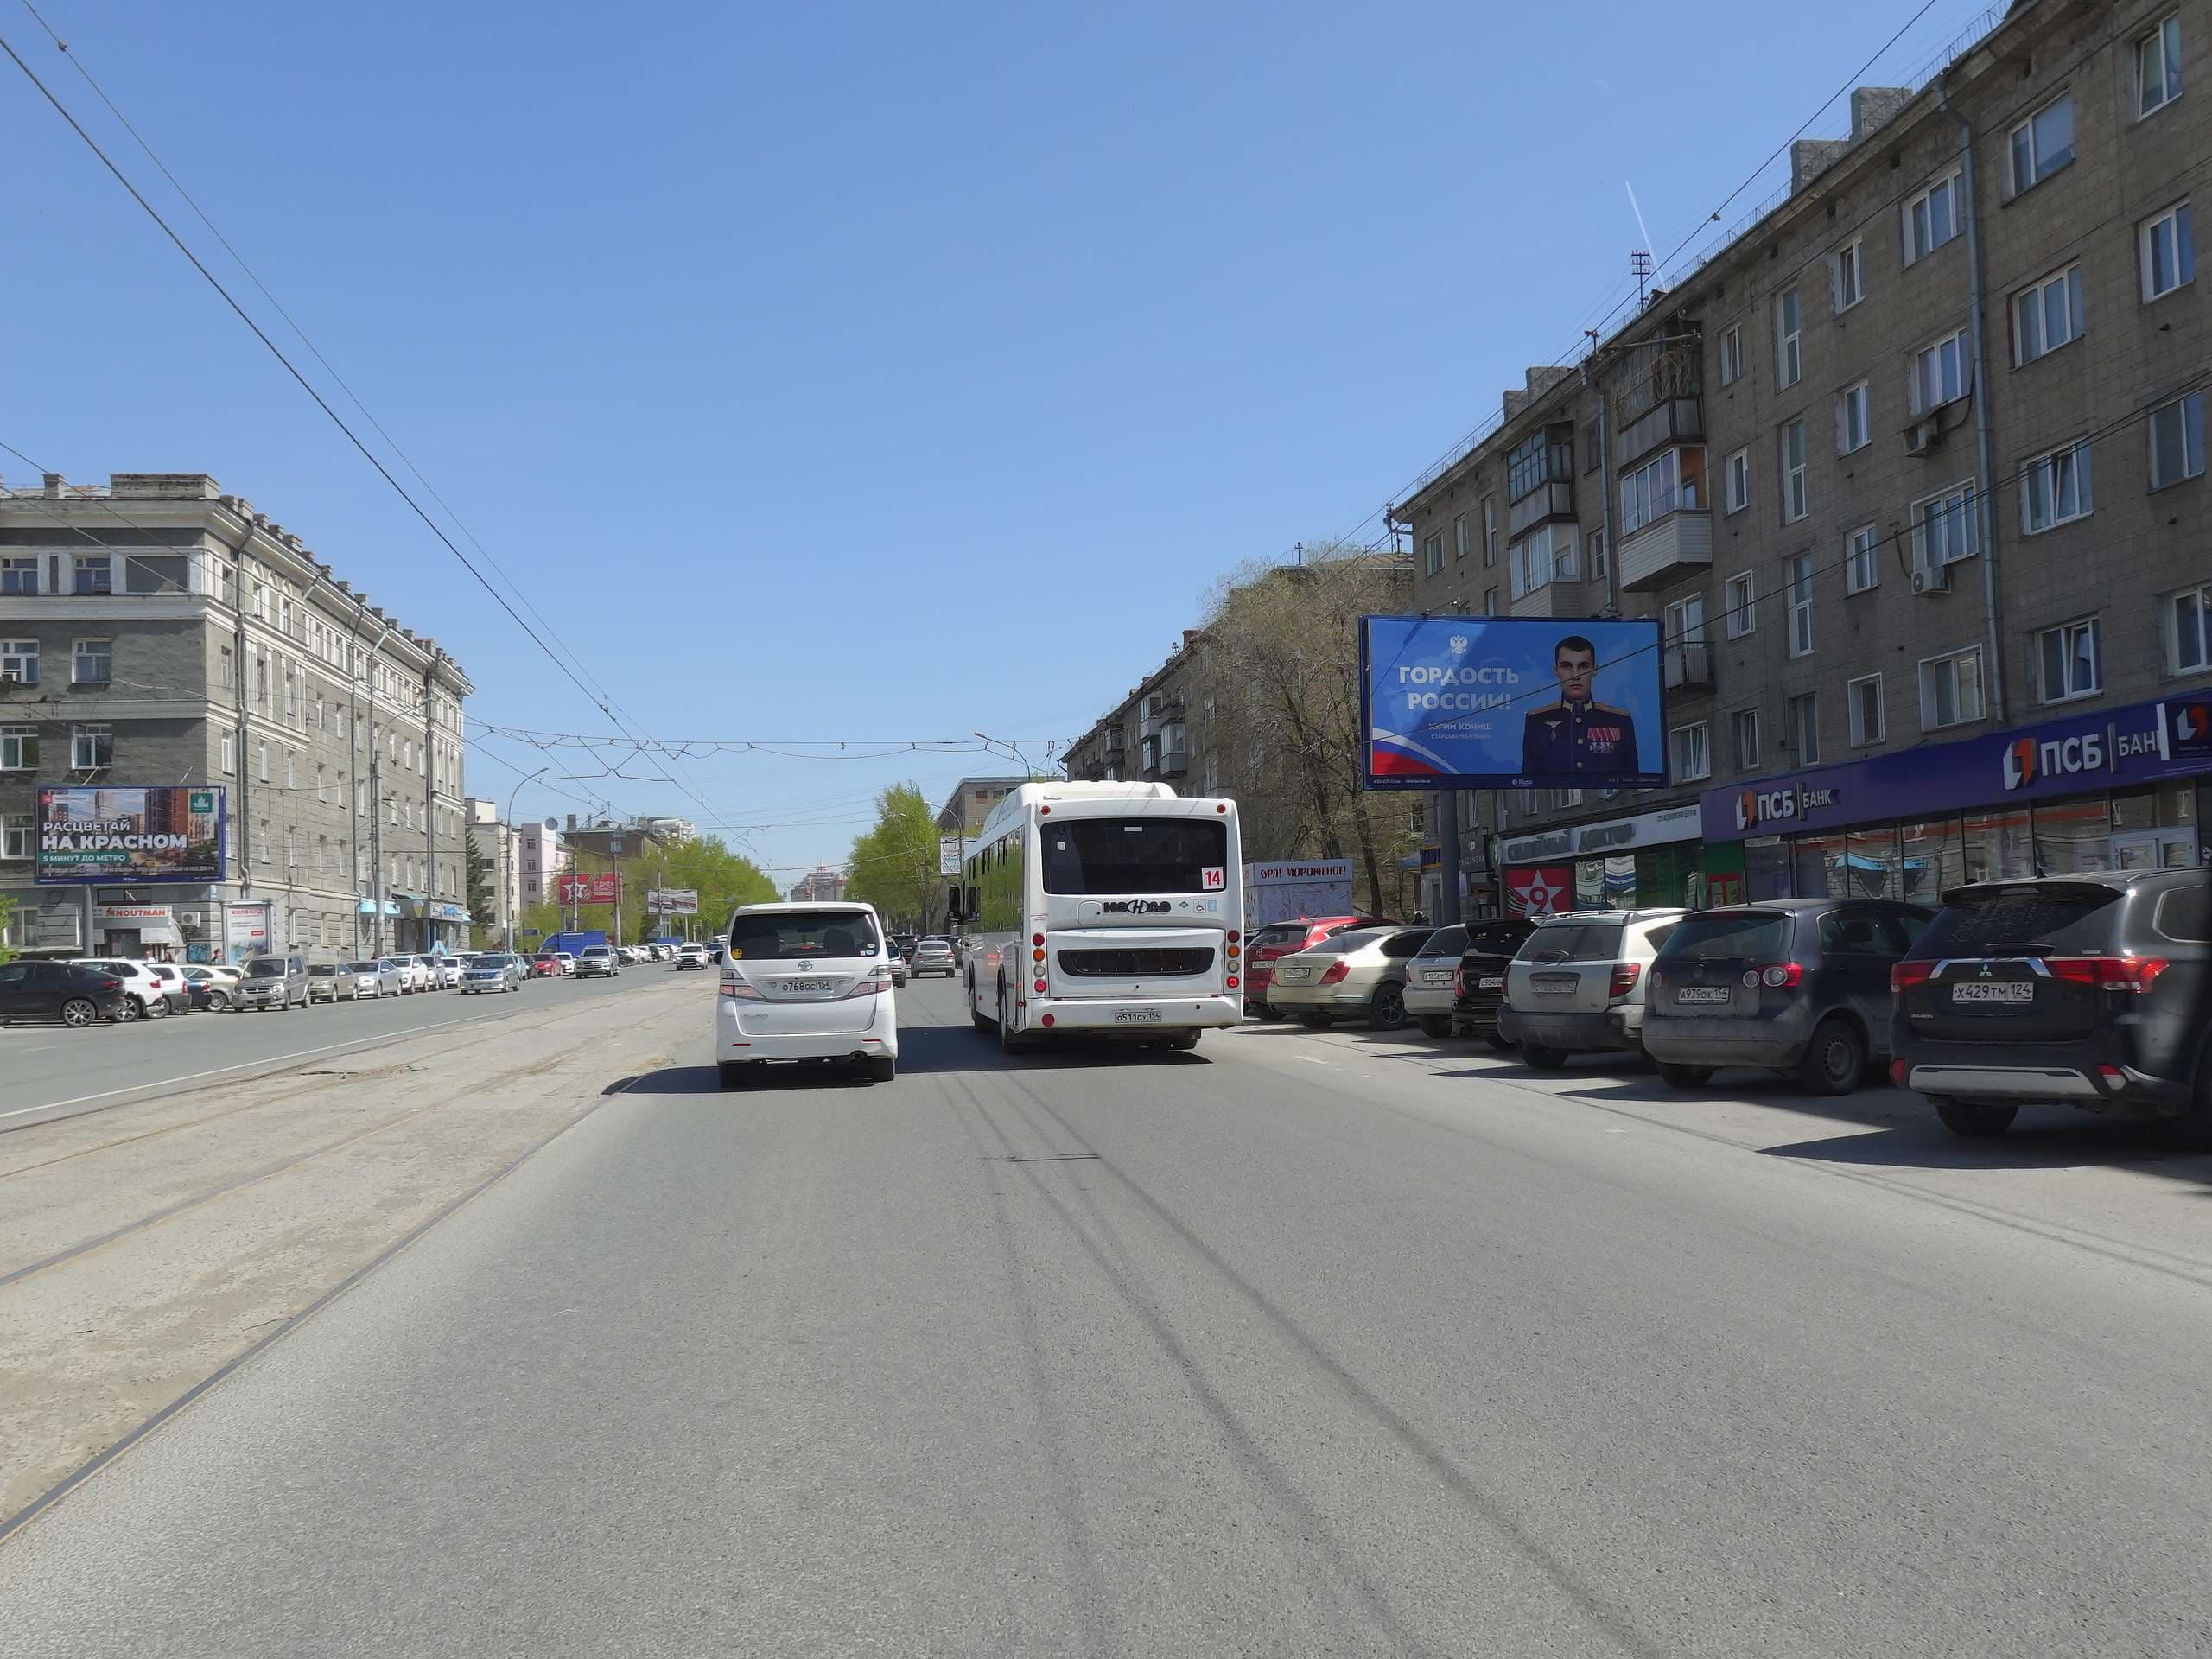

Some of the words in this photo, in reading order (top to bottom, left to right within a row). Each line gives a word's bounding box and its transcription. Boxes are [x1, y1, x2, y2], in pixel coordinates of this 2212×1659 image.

[1398, 666, 1520, 686] ГОРДОСТЬ
[1408, 692, 1512, 711] РОССИИ!
[2040, 734, 2102, 776] ПСБ
[2118, 730, 2160, 757] БАН
[1757, 790, 1795, 821] ПСБ
[1802, 789, 1832, 808] БАНК
[43, 819, 130, 833] РАСЦВЕТАЙ
[42, 835, 74, 849] НА
[80, 834, 188, 849] КРАСНОМ
[1205, 870, 1221, 886] 14
[1286, 866, 1346, 878] МОРОЖЕНОЕ!
[1529, 886, 1549, 912] 9
[817, 981, 831, 989] 154
[1956, 984, 2006, 999] Х429ТМ
[2010, 983, 2031, 995] 124
